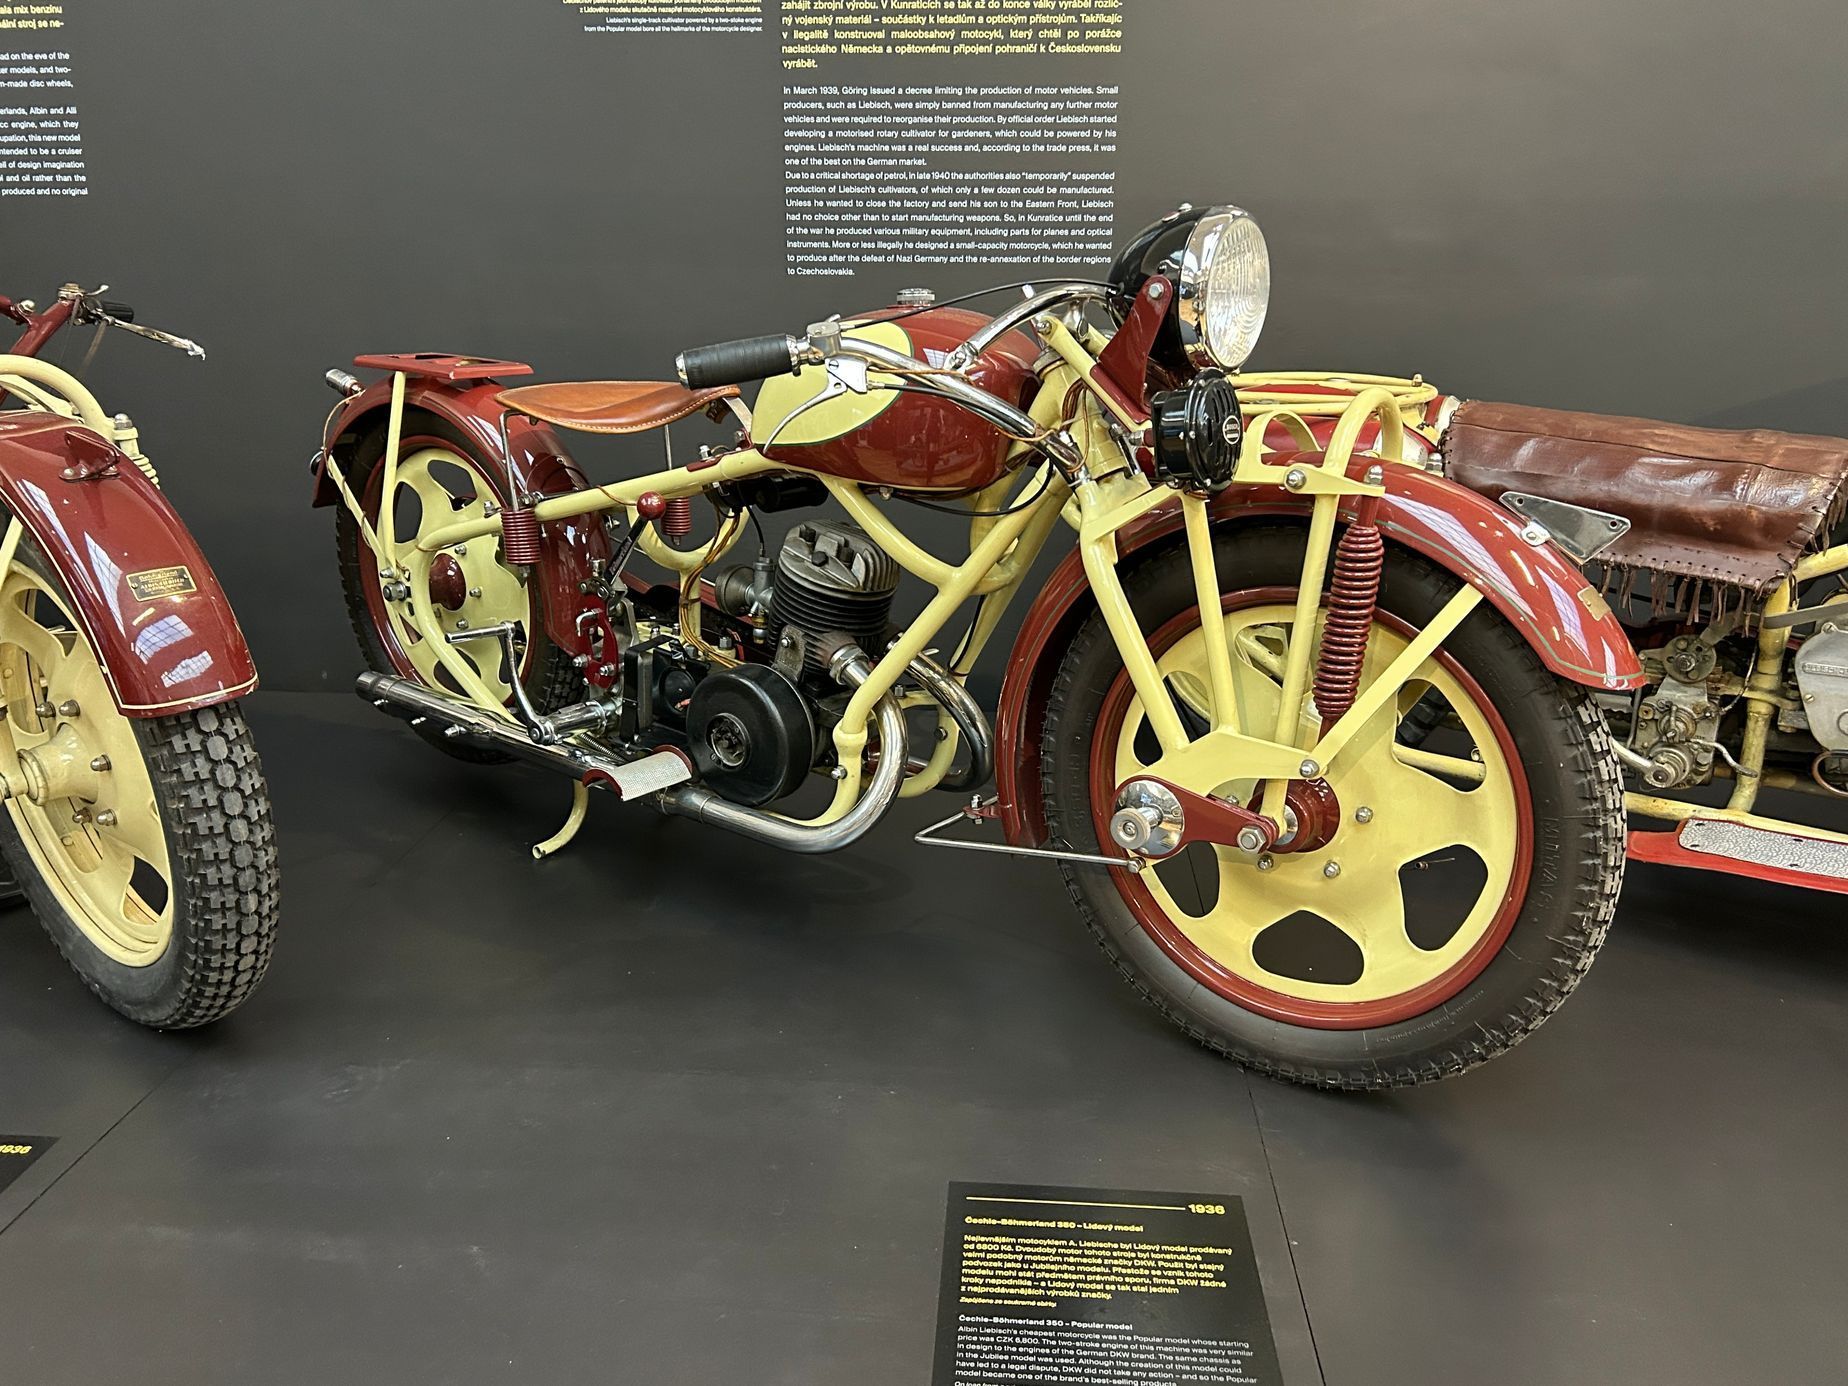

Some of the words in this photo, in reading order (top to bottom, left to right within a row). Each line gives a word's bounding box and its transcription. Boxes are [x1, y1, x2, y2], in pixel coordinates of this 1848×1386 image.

[13, 5, 29, 15] mix
[29, 4, 63, 14] benzínu
[17, 18, 37, 30] stroj
[37, 20, 49, 28] se
[782, 14, 793, 27] ný
[794, 14, 834, 26] vojenský
[835, 14, 872, 25] materiál
[881, 14, 927, 26] součástky
[928, 14, 935, 24] k
[936, 13, 976, 24] letadlům
[977, 15, 984, 24] a
[985, 13, 1028, 26] optickým
[1029, 13, 1078, 26] přístrojům.
[782, 31, 788, 40] v
[834, 29, 886, 39] konstruoval
[891, 28, 956, 40] maloobsahový
[961, 28, 1005, 41] motocykl,
[1010, 28, 1034, 40] který
[1038, 28, 1062, 39] chtěl
[1067, 30, 1080, 40] po
[1085, 28, 1123, 40] porážce
[781, 43, 838, 54] nacistického
[841, 43, 884, 54] Německa
[886, 45, 893, 54] a
[895, 43, 951, 55] opětovnému
[953, 43, 993, 55] připojení
[995, 43, 1038, 55] pohraničí
[1039, 43, 1046, 53] k
[1048, 41, 1122, 53] Československu
[10, 53, 21, 61] on
[20, 52, 34, 60] the
[48, 51, 56, 60] of
[57, 51, 70, 60] the
[782, 58, 818, 70] vyrábět.
[9, 65, 39, 75] models,
[39, 65, 54, 74] and
[54, 66, 72, 74] two-
[29, 79, 45, 88] disc
[45, 79, 74, 88] wheels,
[783, 86, 791, 95] In
[793, 86, 818, 95] March
[819, 86, 840, 96] 1939,
[841, 86, 868, 96] Göring
[870, 86, 896, 95] issued
[897, 87, 903, 95] a
[905, 86, 933, 95] decree
[934, 86, 963, 96] limiting
[964, 86, 978, 95] the
[980, 86, 1022, 96] production
[1023, 86, 1033, 95] of
[1034, 86, 1058, 95] motor
[1059, 86, 1094, 95] vehicles.
[1096, 85, 1119, 95] Small
[29, 106, 48, 115] Albin
[49, 106, 64, 115] and
[10, 120, 38, 130] engine,
[39, 120, 61, 128] which
[62, 120, 79, 130] they
[27, 133, 42, 142] this
[57, 133, 81, 142] model
[784, 129, 826, 139] developing
[828, 130, 834, 138] a
[835, 129, 874, 138] motorised
[876, 129, 899, 139] rotary
[901, 129, 936, 138] cultivator
[938, 129, 949, 138] for
[951, 129, 993, 139] gardeners,
[994, 129, 1018, 138] which
[1019, 129, 1042, 138] could
[1043, 129, 1055, 138] be
[1056, 129, 1091, 139] powered
[1093, 129, 1103, 139] by
[1105, 129, 1117, 138] his
[39, 147, 50, 155] be
[57, 147, 83, 155] cruiser
[8, 160, 16, 169] of
[17, 161, 42, 170] design
[42, 160, 85, 170] imagination
[5, 174, 20, 182] and
[21, 174, 31, 182] oil
[32, 174, 54, 182] rather
[55, 174, 73, 182] than
[73, 174, 87, 182] the
[1, 187, 36, 196] produced
[36, 187, 51, 195] and
[61, 187, 89, 197] original
[785, 198, 812, 207] Unless
[813, 199, 824, 207] he
[825, 199, 854, 208] wanted
[855, 199, 864, 208] to
[865, 199, 887, 208] close
[888, 199, 902, 208] the
[903, 199, 930, 209] factory
[931, 199, 946, 208] and
[948, 199, 968, 208] send
[969, 199, 982, 208] his
[1000, 200, 1009, 208] to
[1010, 199, 1024, 208] the
[1025, 199, 1055, 208] Eastern
[1057, 199, 1079, 209] Front,
[1081, 199, 1114, 208] Liebisch
[787, 267, 796, 275] to
[796, 266, 855, 276] Czechoslovakia.
[0, 1145, 33, 1155] 1936
[1188, 1203, 1226, 1215] 1936
[1056, 1221, 1076, 1229] 350
[1082, 1222, 1114, 1232] Lidový
[1046, 1319, 1064, 1327] 350
[1071, 1320, 1105, 1329] Popular
[1105, 1323, 1133, 1331] model
[1017, 1329, 1056, 1337] cheapest
[1057, 1331, 1101, 1340] motorcycle
[1117, 1334, 1132, 1342] the
[1133, 1334, 1163, 1343] Popular
[1164, 1337, 1190, 1345] model
[1190, 1338, 1218, 1346] whose
[1218, 1340, 1250, 1349] starting
[957, 1334, 979, 1342] price
[1041, 1338, 1057, 1346] The
[1057, 1339, 1100, 1348] two-stroke
[1101, 1342, 1130, 1350] engine
[1155, 1345, 1191, 1354] machine
[1227, 1349, 1254, 1357] similar
